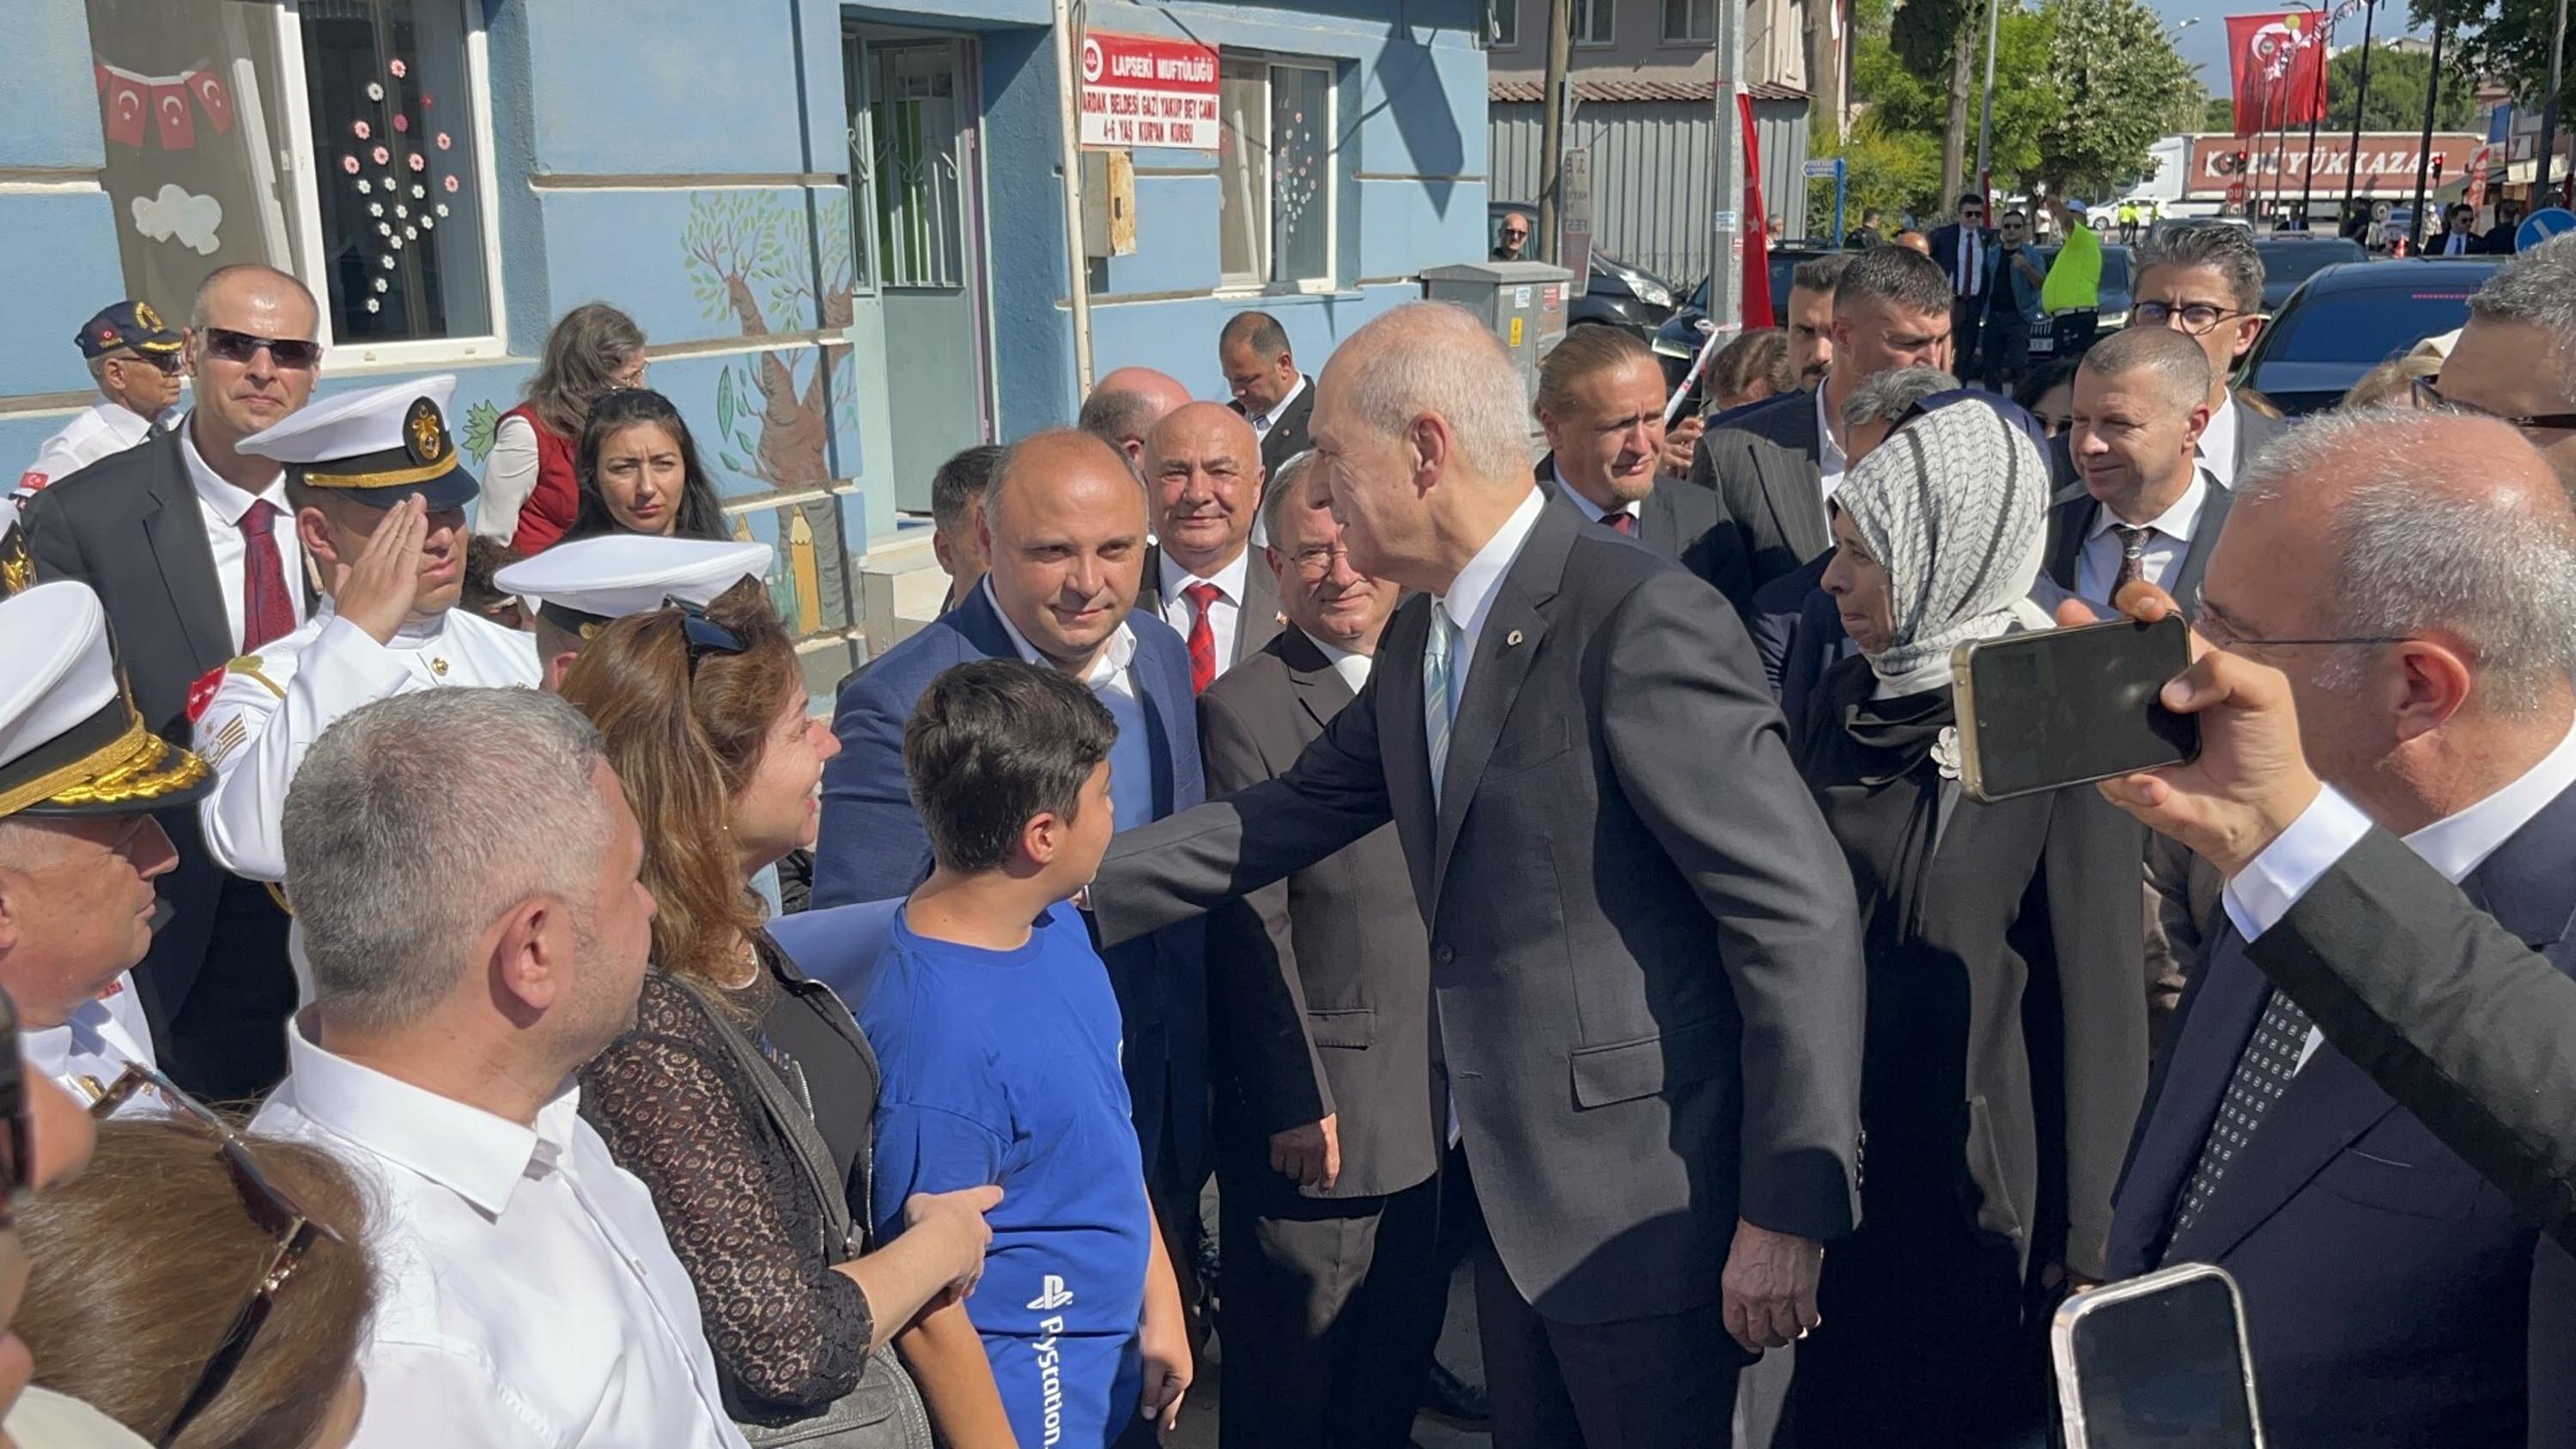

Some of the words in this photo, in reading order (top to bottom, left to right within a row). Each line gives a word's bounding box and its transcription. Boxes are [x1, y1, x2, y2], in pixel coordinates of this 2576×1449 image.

[1111, 52, 1154, 78] LAPSEKİ
[1083, 92, 1107, 113] ARDAK
[1170, 123, 1194, 144] KURSU
